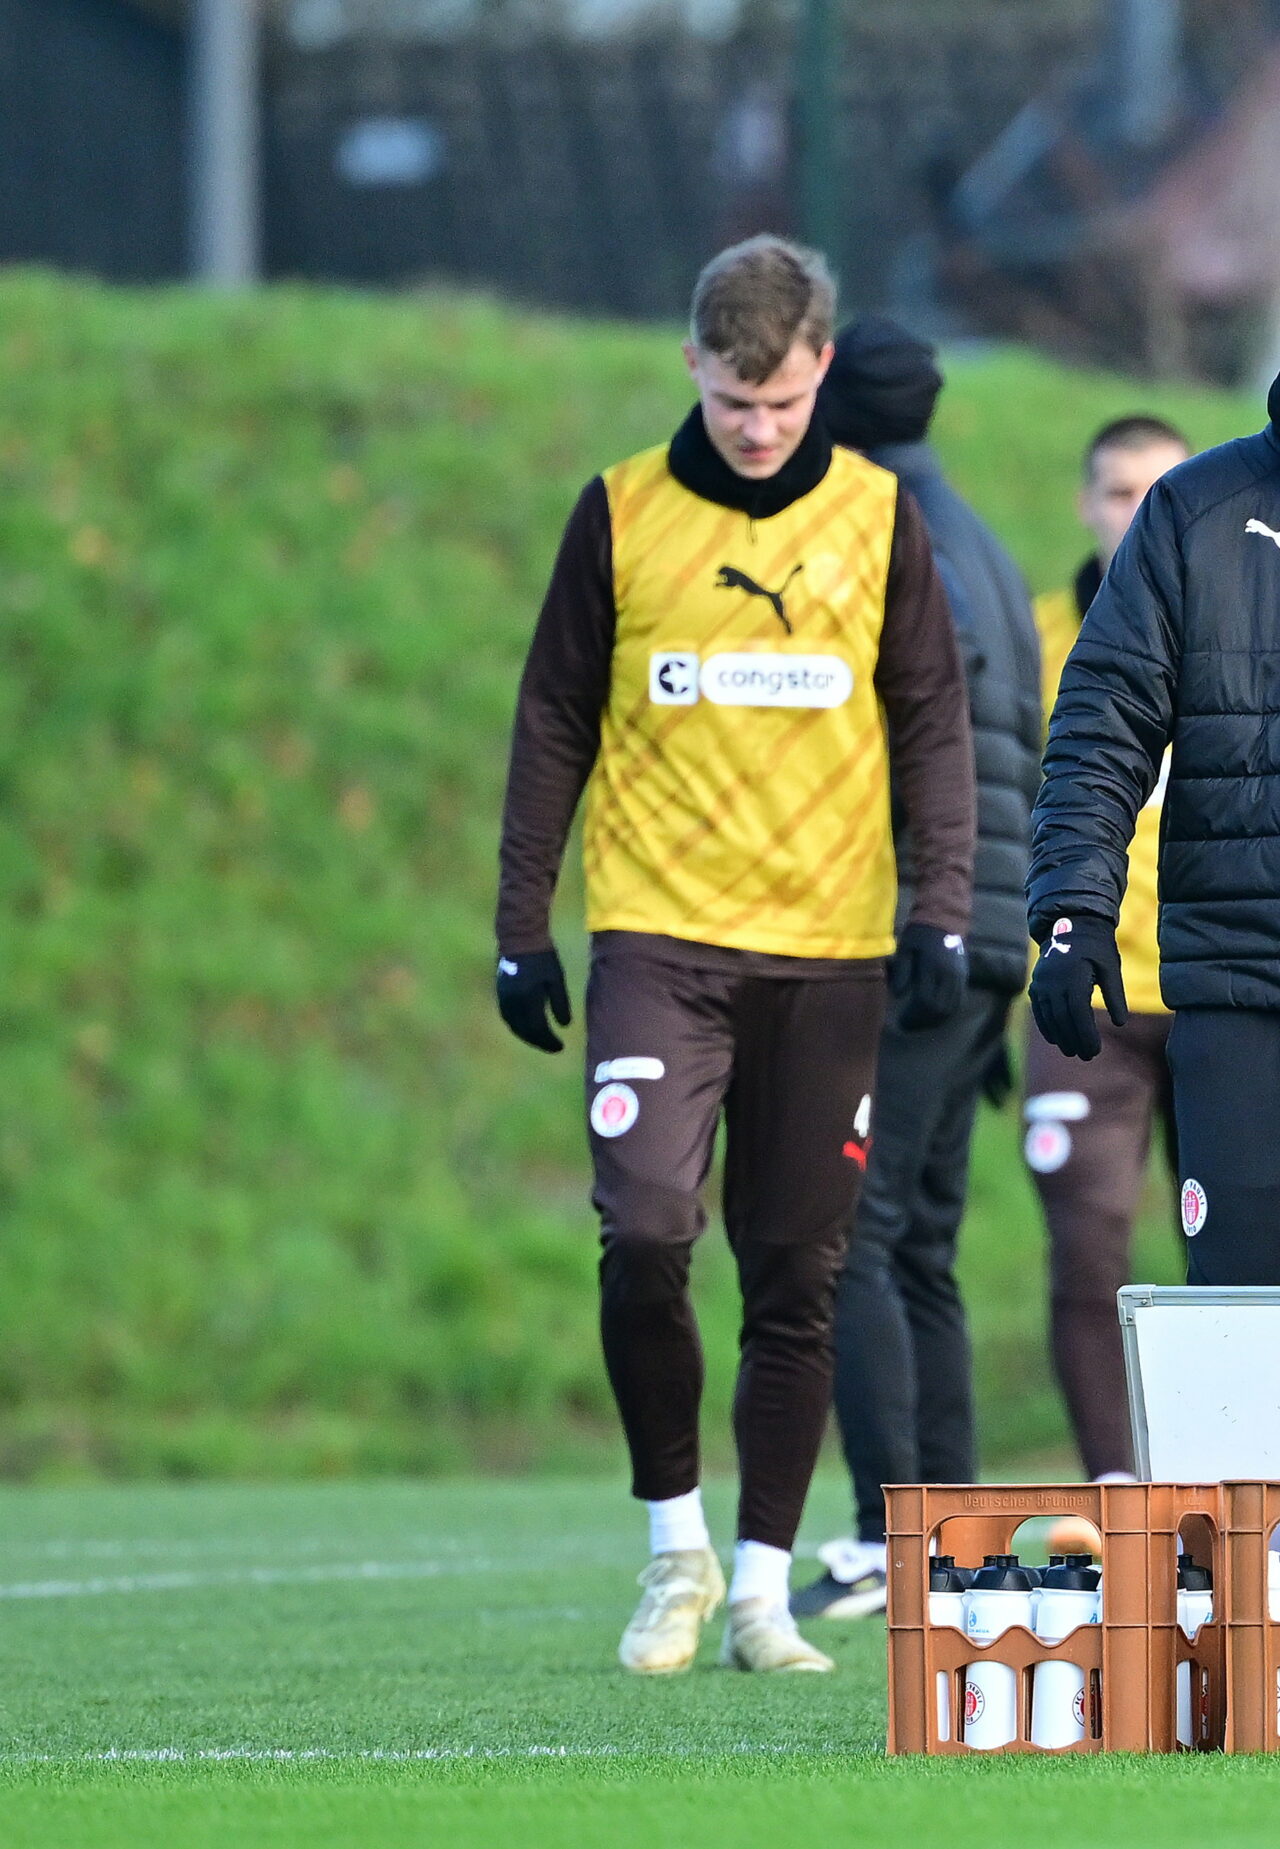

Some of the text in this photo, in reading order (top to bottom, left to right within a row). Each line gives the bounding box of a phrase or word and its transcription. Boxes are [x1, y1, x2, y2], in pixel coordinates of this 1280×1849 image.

[717, 667, 835, 695] congstar
[964, 1493, 1092, 1508] Deutscher Brunnen
